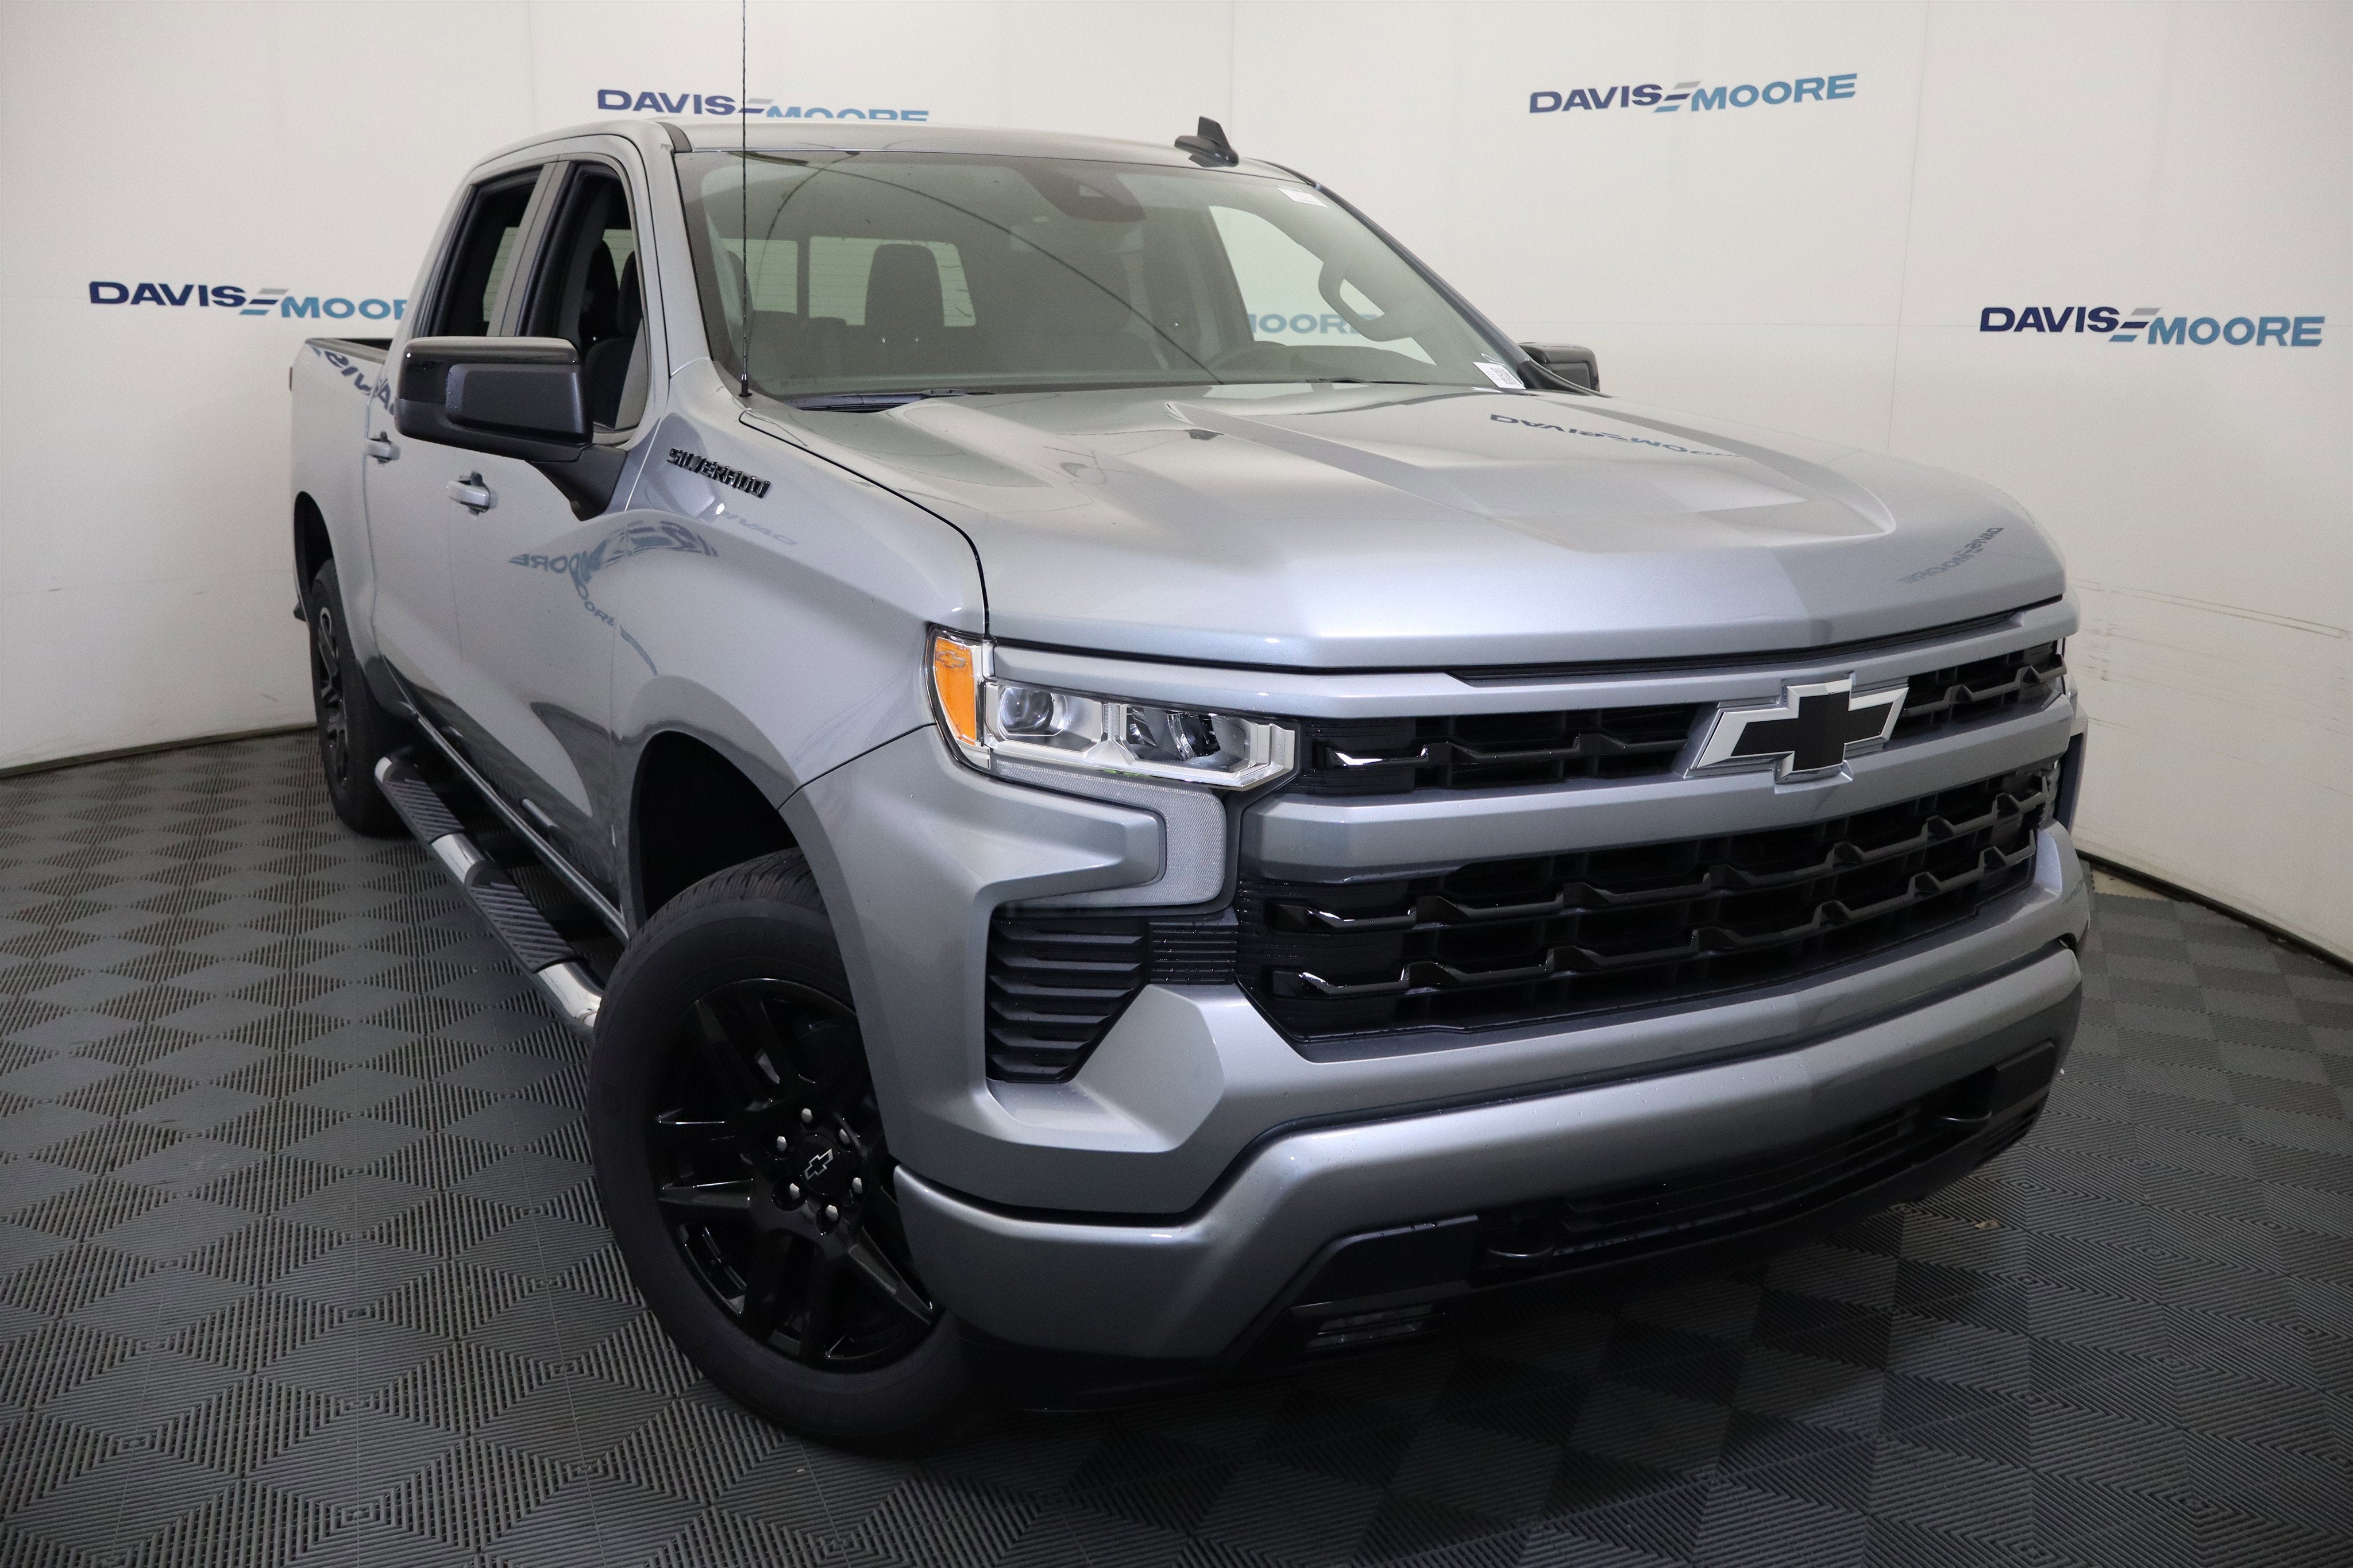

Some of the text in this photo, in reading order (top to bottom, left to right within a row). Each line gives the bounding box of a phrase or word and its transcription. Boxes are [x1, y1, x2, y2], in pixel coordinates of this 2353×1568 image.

[597, 89, 737, 116] DAVIS
[1529, 73, 1858, 114] DAVIS MOORE
[88, 280, 407, 321] DAVIS MOO
[1248, 314, 1378, 334] OOR
[1980, 306, 2326, 347] DAVIS MOORE
